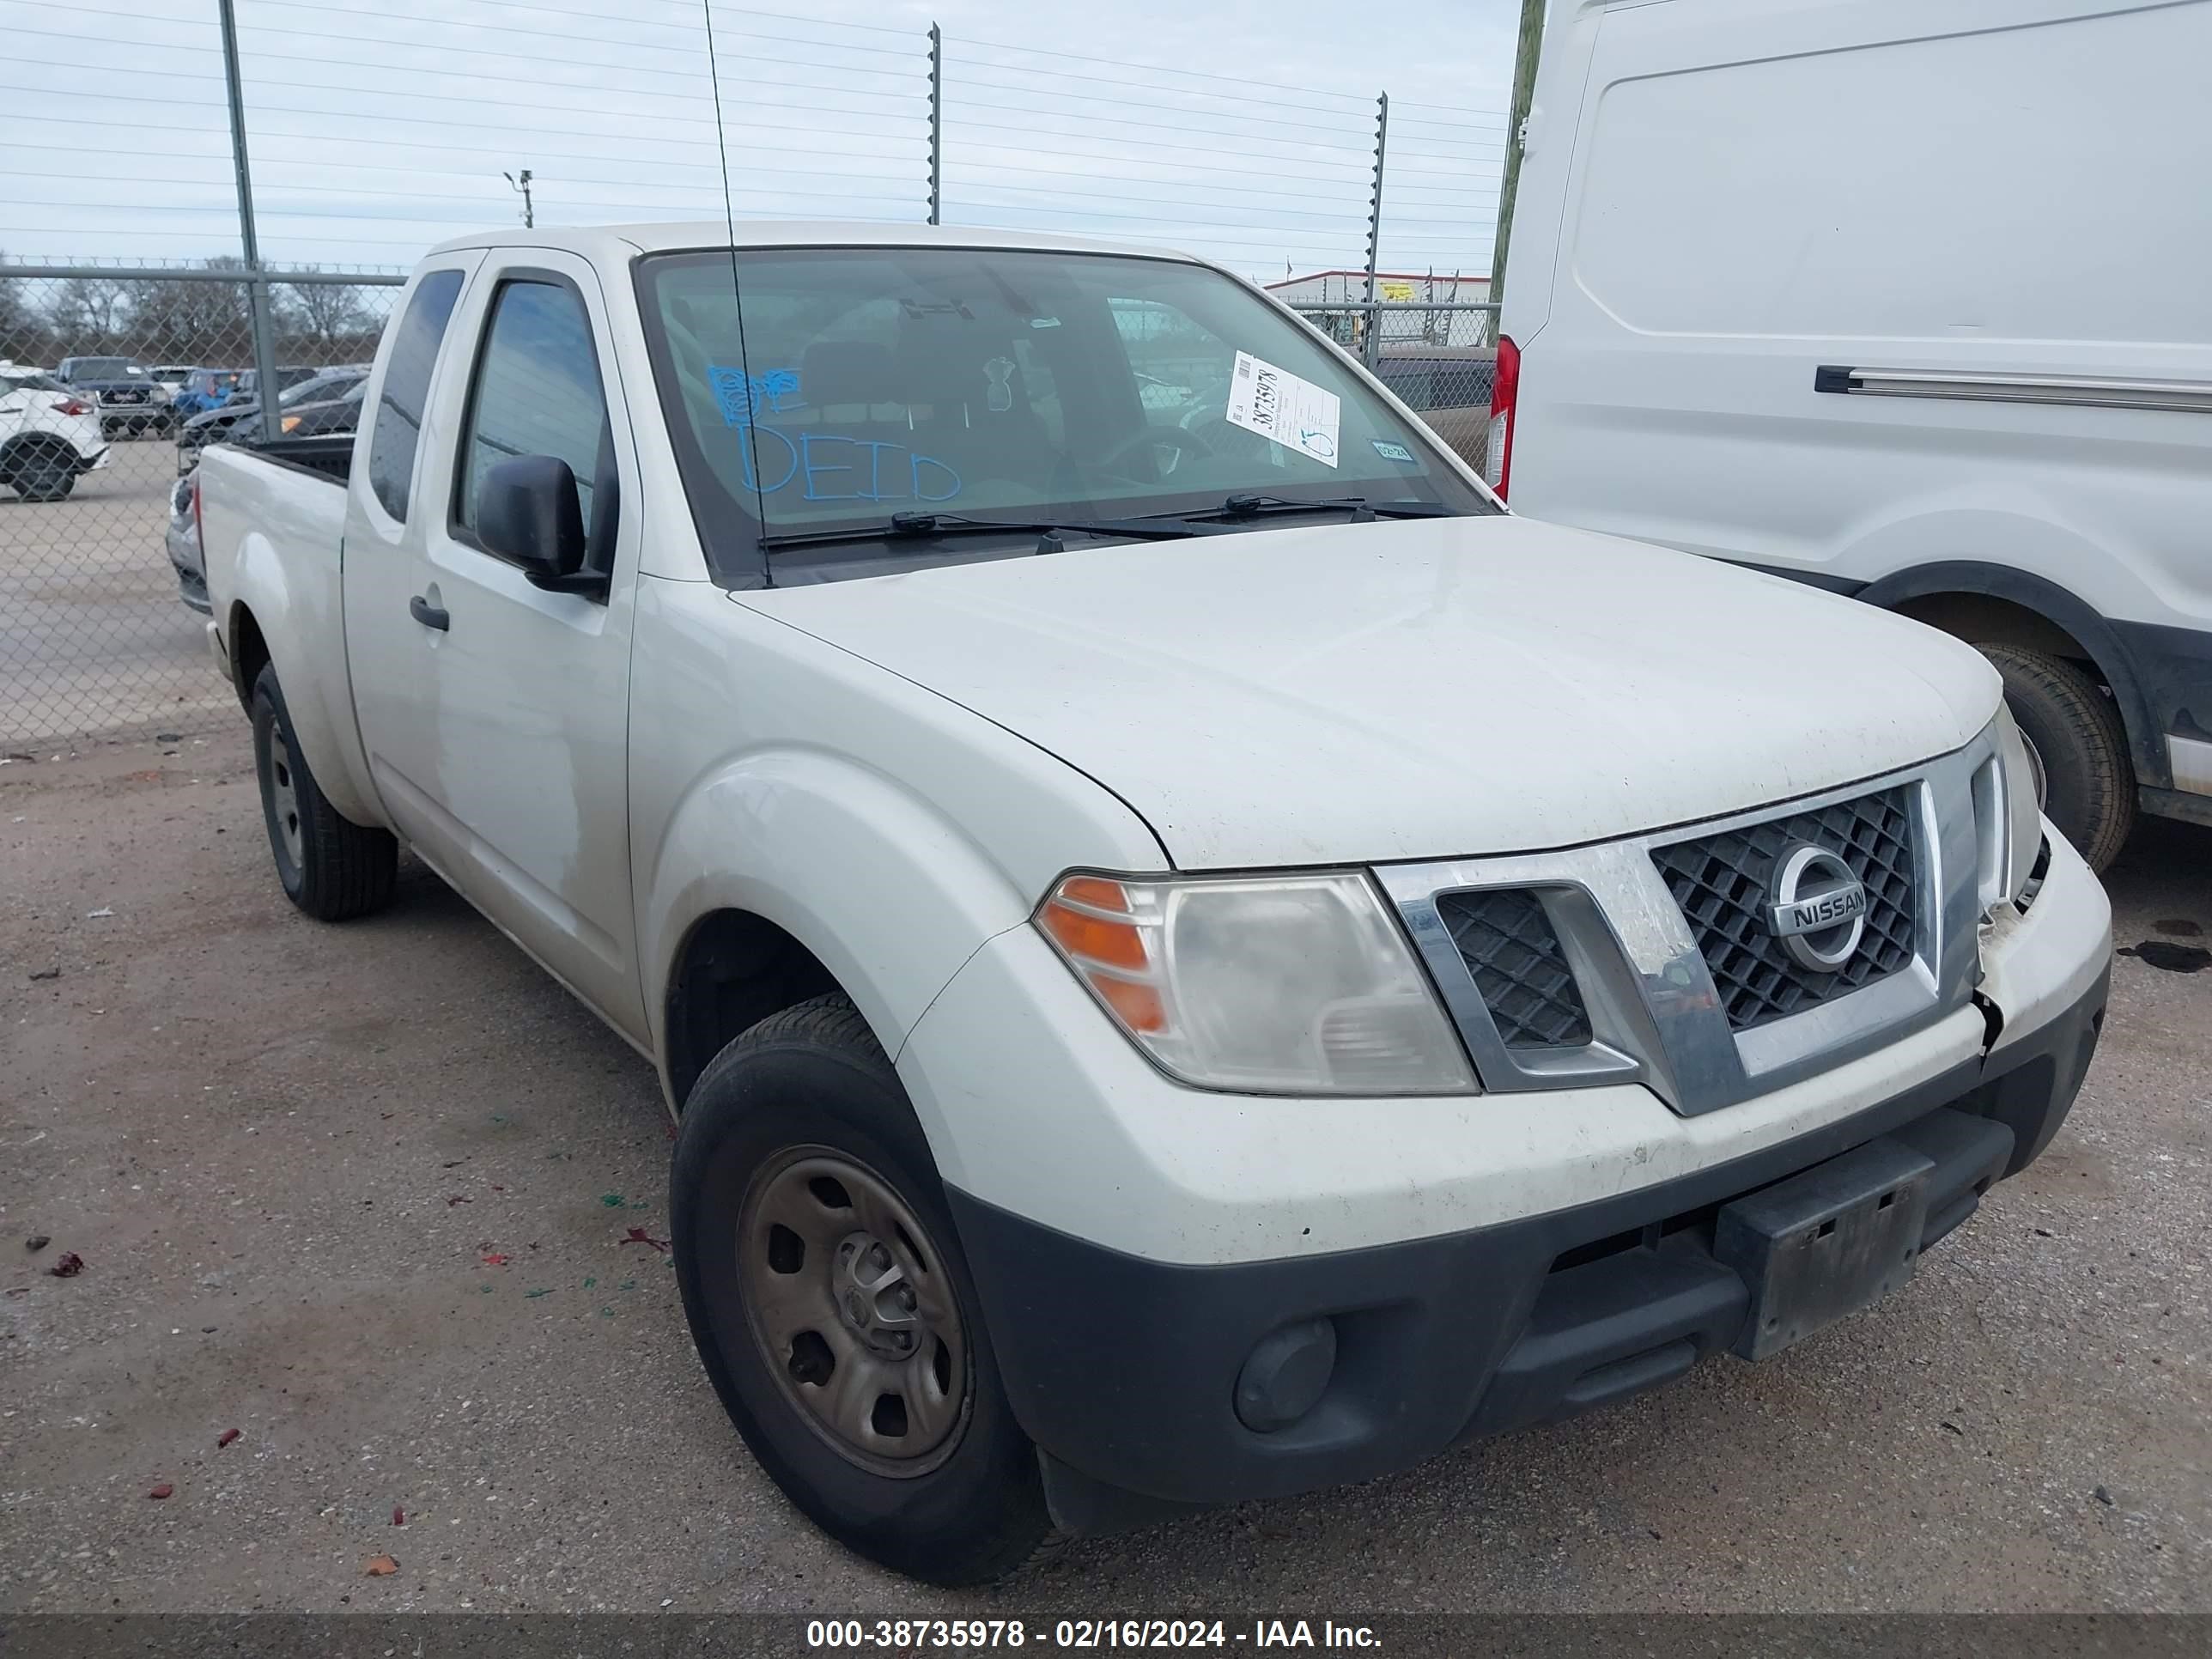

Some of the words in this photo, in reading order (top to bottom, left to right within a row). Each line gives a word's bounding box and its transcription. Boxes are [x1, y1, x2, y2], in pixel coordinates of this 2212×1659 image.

[1252, 368, 1278, 430] 38735978
[737, 422, 961, 501] DEID
[1794, 890, 1864, 928] NISSAN
